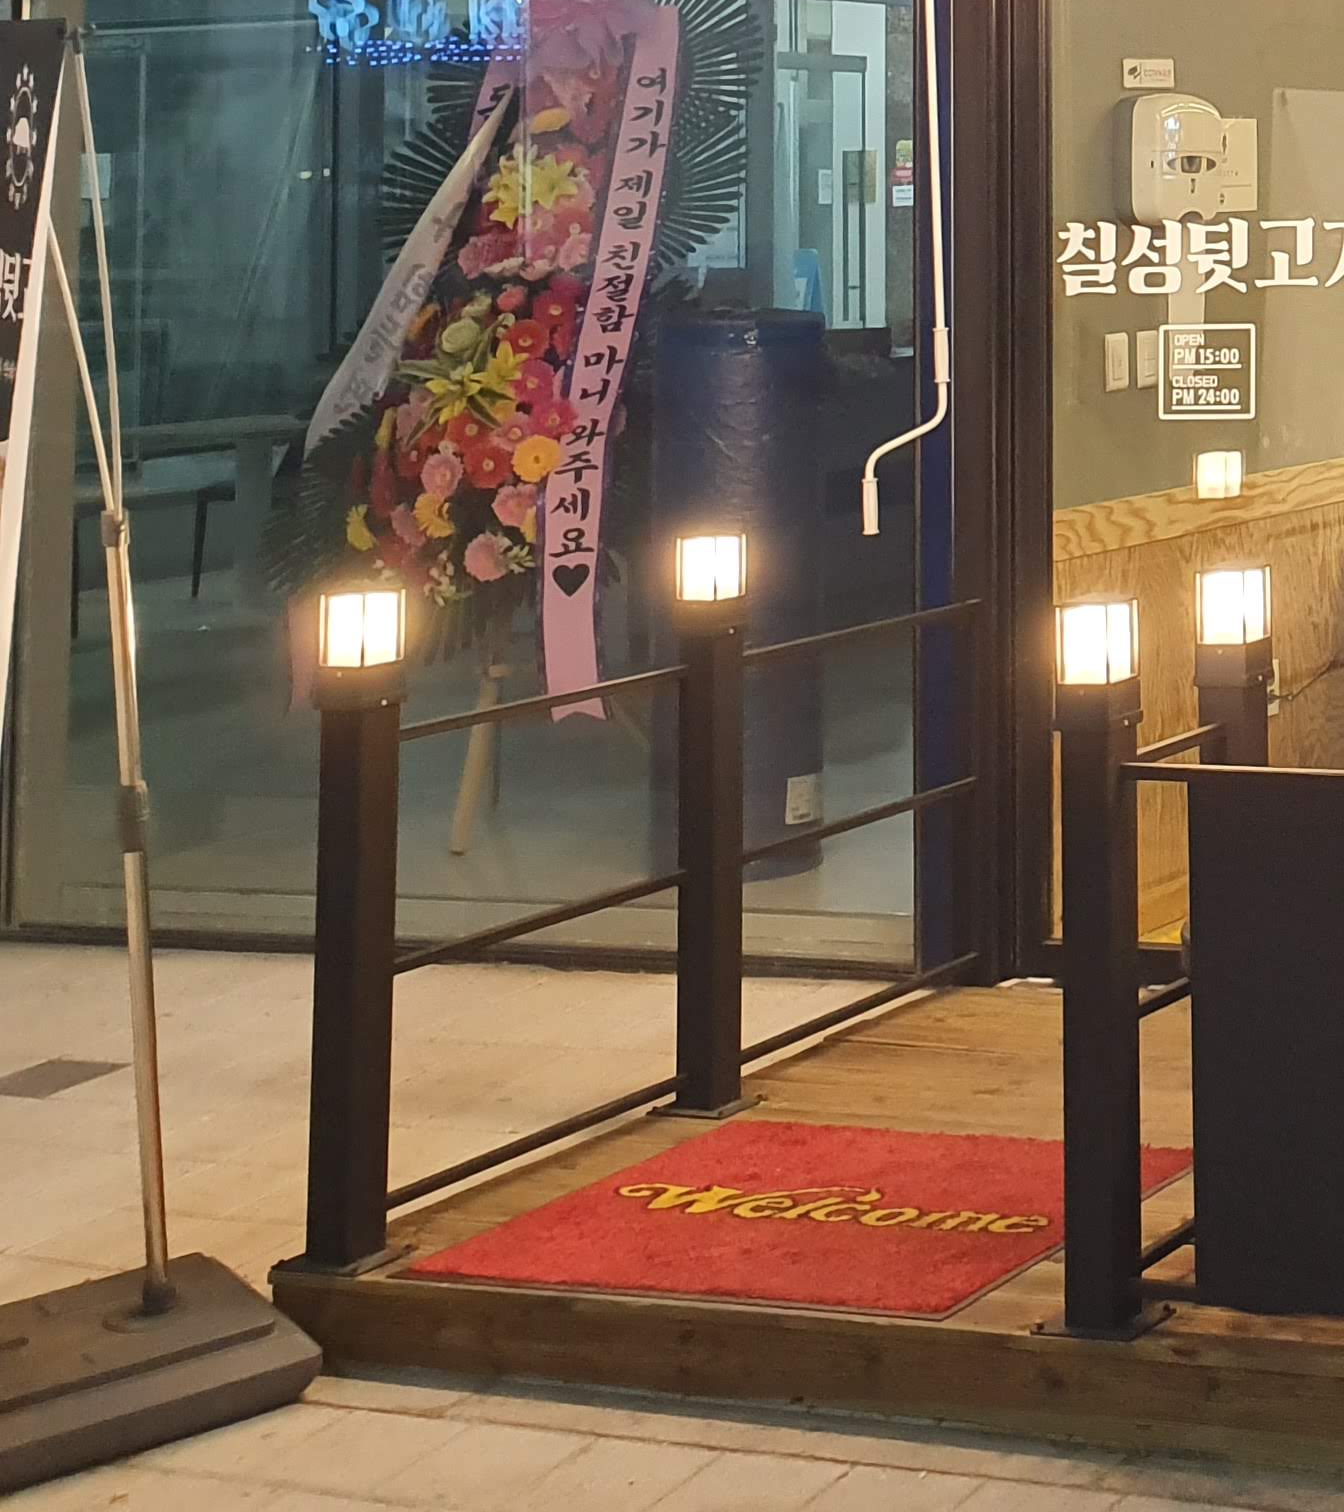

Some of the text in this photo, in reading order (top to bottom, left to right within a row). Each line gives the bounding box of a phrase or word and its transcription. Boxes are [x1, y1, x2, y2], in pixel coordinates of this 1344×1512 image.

[625, 67, 668, 159] 여기가
[612, 169, 653, 230] 제일
[591, 241, 642, 334] 친절함
[1173, 348, 1240, 364] PM 15:00
[1174, 334, 1205, 346] OPEN
[579, 344, 625, 406] 마니
[1172, 375, 1218, 388] CLOSED
[1172, 388, 1240, 405] PM 24:00
[618, 1182, 1049, 1234] Welcome
